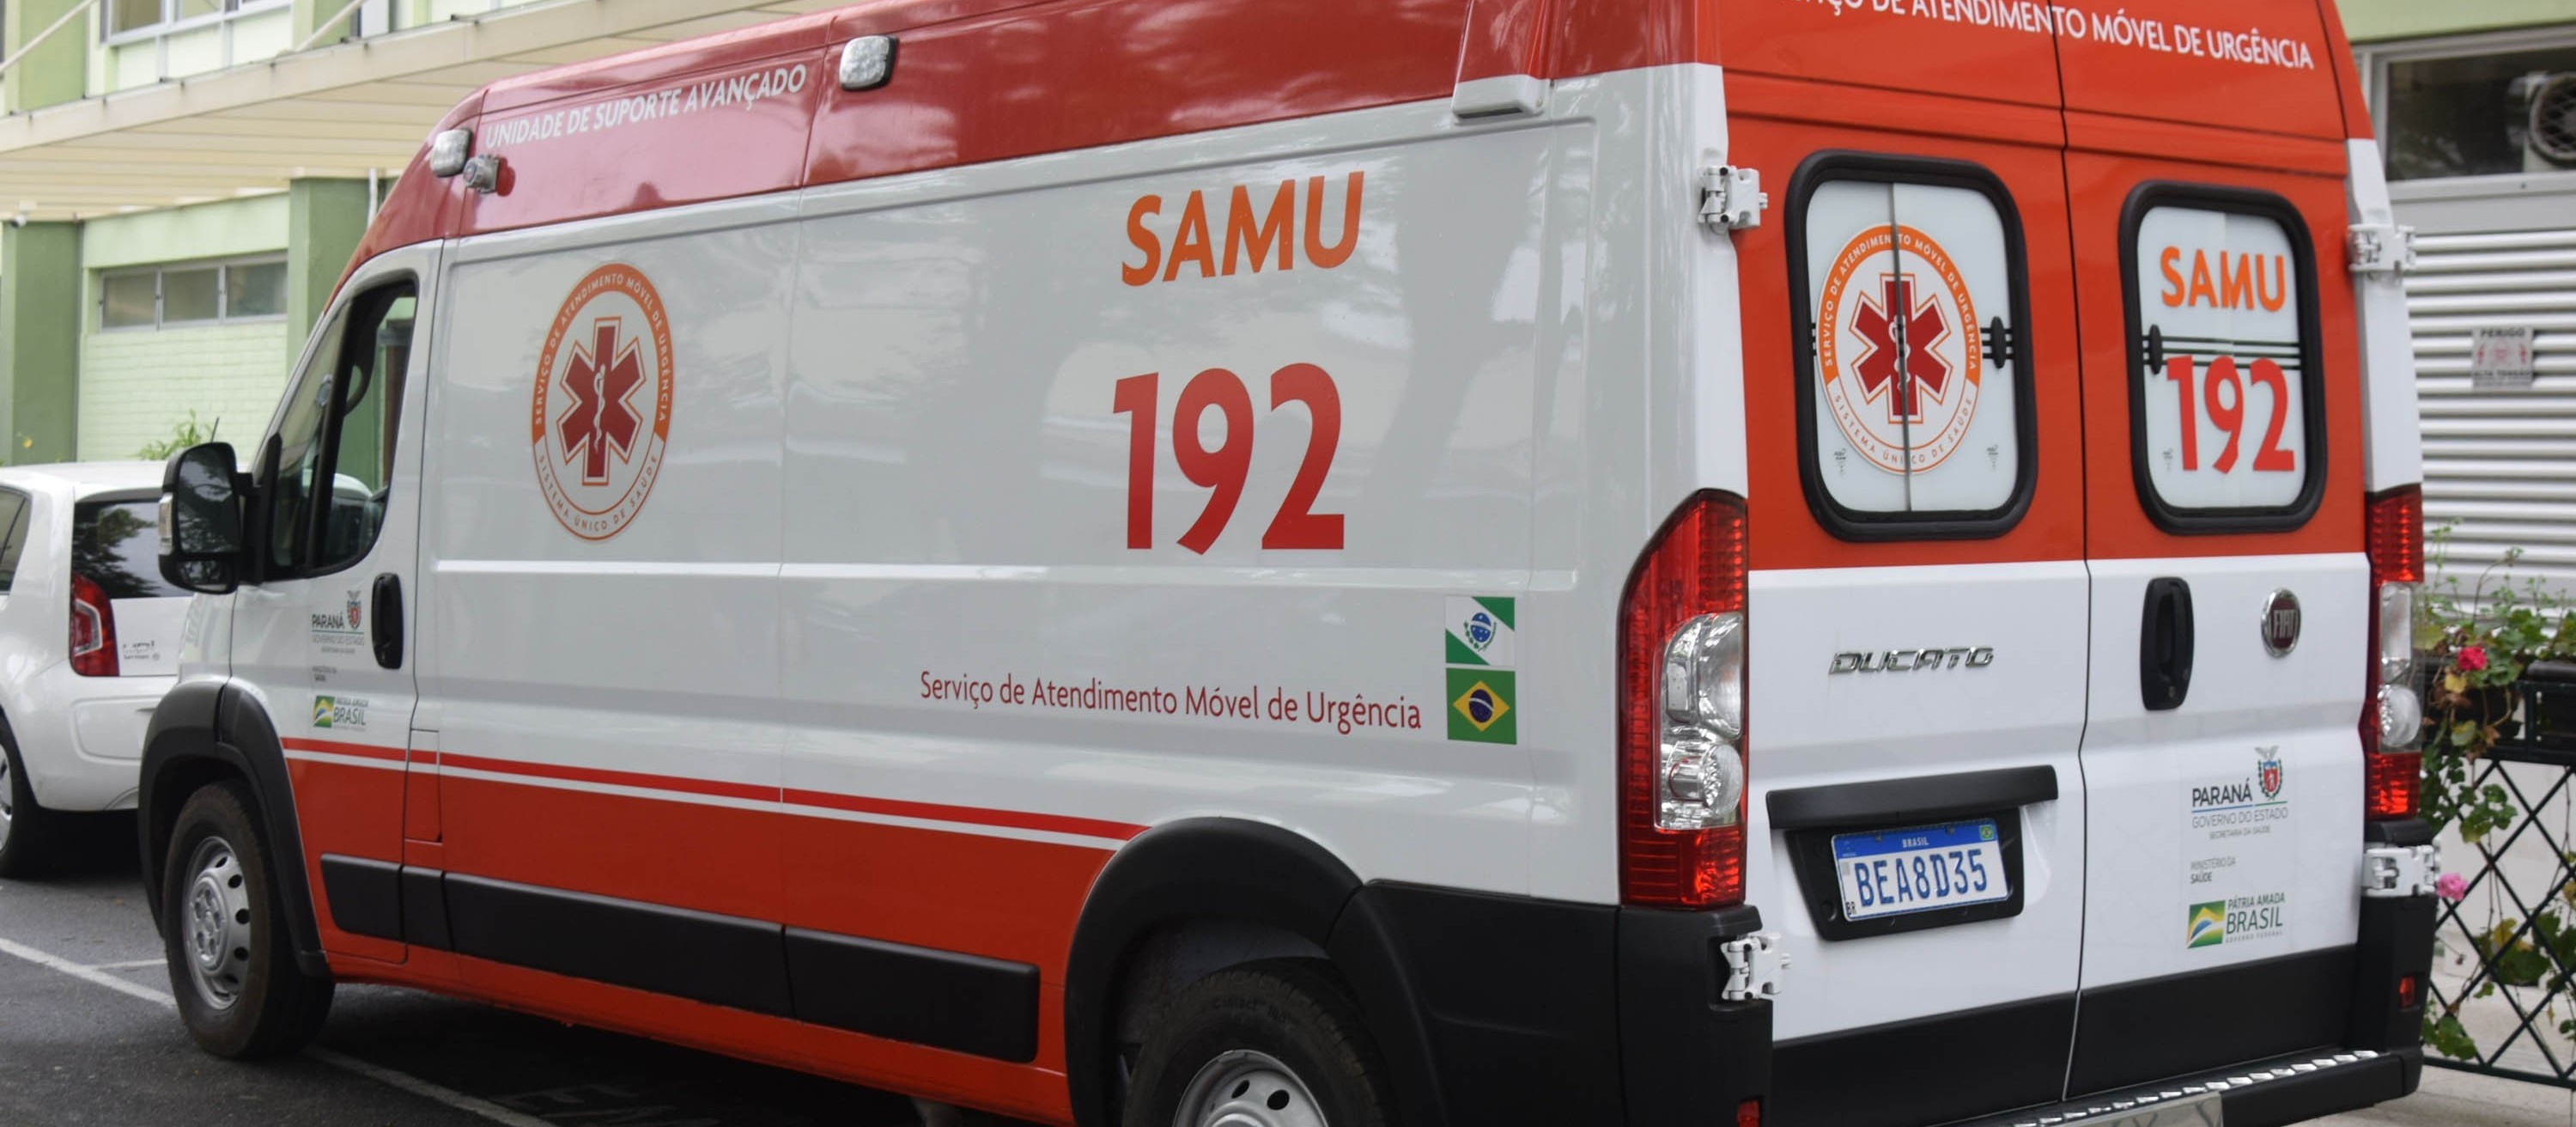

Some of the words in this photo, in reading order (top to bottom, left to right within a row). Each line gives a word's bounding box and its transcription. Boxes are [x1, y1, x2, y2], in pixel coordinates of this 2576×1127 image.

[1911, 0, 2086, 39] ATENDIMENTO
[2092, 9, 2172, 52] MÓVEL
[2174, 25, 2204, 57] DE
[2206, 27, 2315, 70] URGÊNCIA
[485, 116, 562, 148] UNIDADE
[567, 107, 592, 135] DE
[593, 88, 682, 131] SUPORTE
[683, 64, 807, 113] AVANÇADO
[1121, 171, 1364, 286] SAMU
[1823, 301, 1834, 367] SERVIÇO
[1830, 278, 1842, 296] DE
[1839, 233, 1911, 276] ATENDIMENTO
[1915, 239, 1946, 271] MÓVEL
[1947, 272, 1959, 289] DE
[1958, 294, 1977, 369] URGÊNCIA
[2160, 246, 2286, 312] SAMU
[535, 355, 551, 425] SERVIÇO
[550, 328, 561, 349] DE
[560, 273, 624, 326] ATENDIMENTO
[626, 276, 654, 310] MÓVEL
[652, 310, 663, 331] DE
[1834, 395, 1875, 453] SISTEMA
[1932, 444, 1944, 457] DE
[2166, 354, 2295, 474] 192
[539, 454, 569, 517] SISTEMA
[613, 509, 627, 525] DE
[1113, 362, 1346, 556] 192
[312, 612, 345, 629] PARANÁ
[2271, 609, 2296, 638] FIAT
[1829, 646, 1994, 674] DUCATO
[333, 706, 367, 726] BRASIL
[920, 671, 994, 710] Serviço
[999, 674, 1024, 704] de
[1031, 677, 1176, 715] Atendimento
[1185, 679, 1260, 719] Móvel
[1267, 683, 1297, 722] de
[1307, 691, 1422, 734] Urgência
[2192, 778, 2252, 807] PARANÁ
[2192, 813, 2237, 829] GOVERNO
[2239, 811, 2251, 823] DO
[2255, 807, 2288, 822] ESTADO
[1903, 837, 1929, 848] BRASIL
[1855, 849, 1988, 907] BEA8D35
[2227, 896, 2255, 911] PÁTRIA
[2257, 892, 2285, 907] AMADA
[2227, 906, 2283, 935] BRASIL
